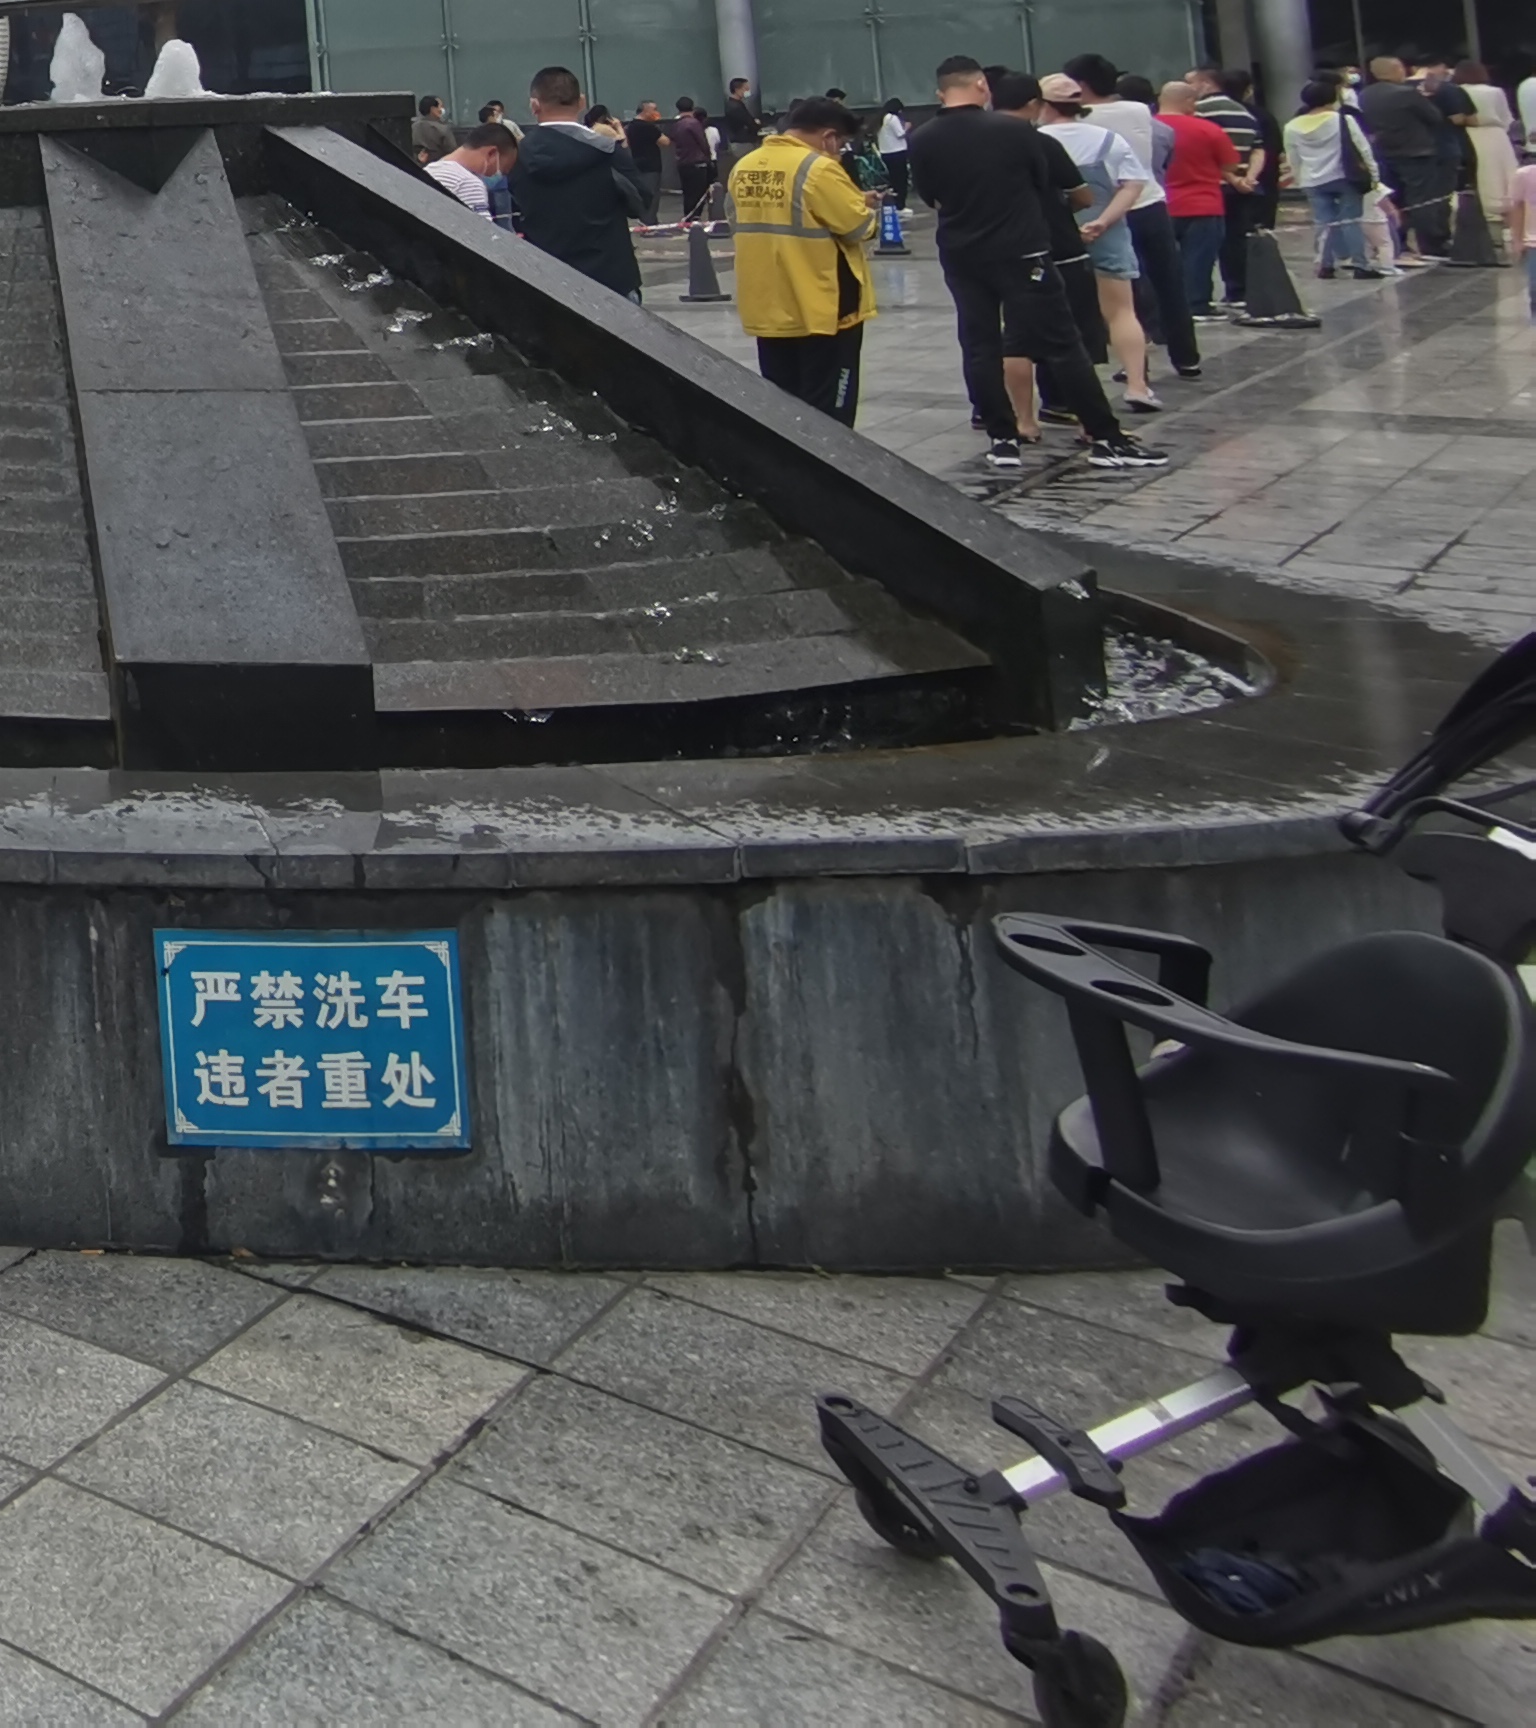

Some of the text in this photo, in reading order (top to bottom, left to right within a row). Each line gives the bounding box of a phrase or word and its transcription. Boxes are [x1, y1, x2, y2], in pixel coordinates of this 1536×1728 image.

[189, 969, 429, 1030] 严禁洗车
[193, 1048, 437, 1110] 违者重处
